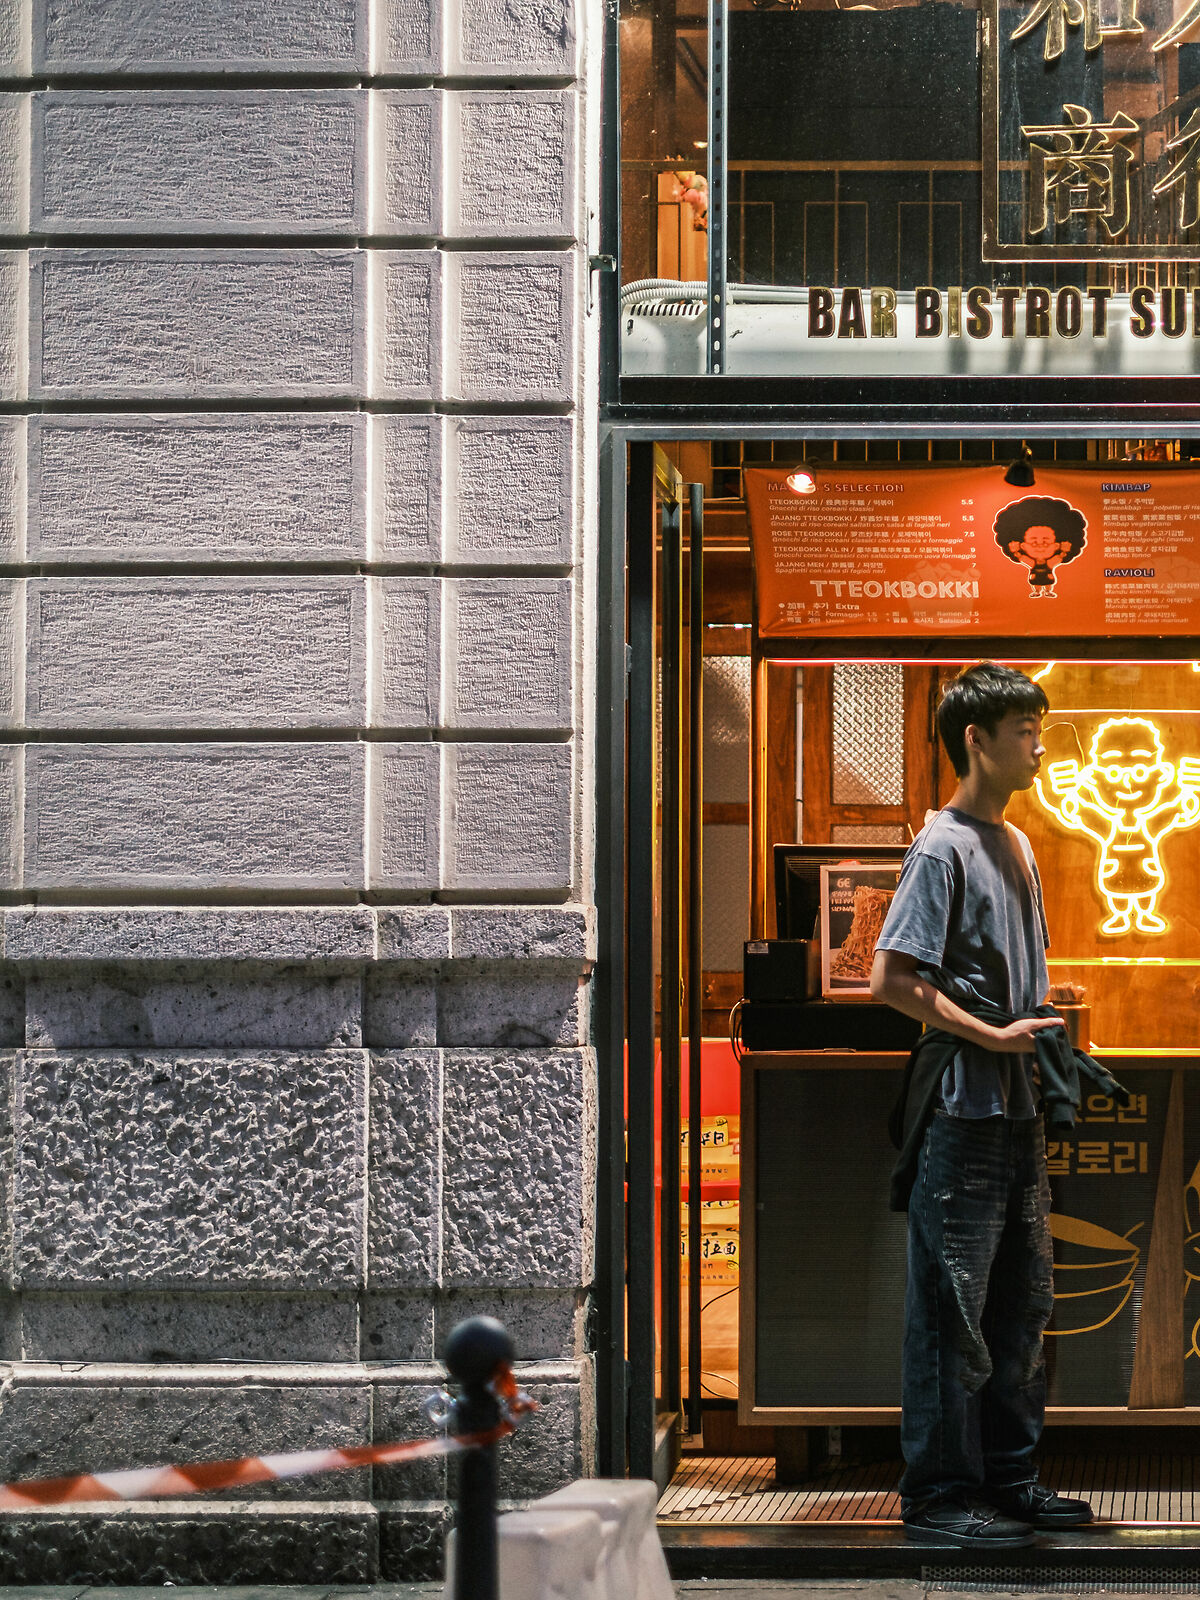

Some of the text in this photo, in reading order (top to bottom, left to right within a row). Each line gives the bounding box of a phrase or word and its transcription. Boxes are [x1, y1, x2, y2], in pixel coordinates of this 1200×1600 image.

[807, 286, 898, 339] BAR
[915, 286, 1113, 339] BISTROT
[835, 484, 904, 492] SELECTION
[1102, 483, 1151, 491] KIMBAP
[961, 498, 974, 506] 5.5
[1104, 568, 1154, 577] RAVIOLI
[810, 580, 979, 598] TTEOKBOKKI
[835, 602, 860, 610] Extra
